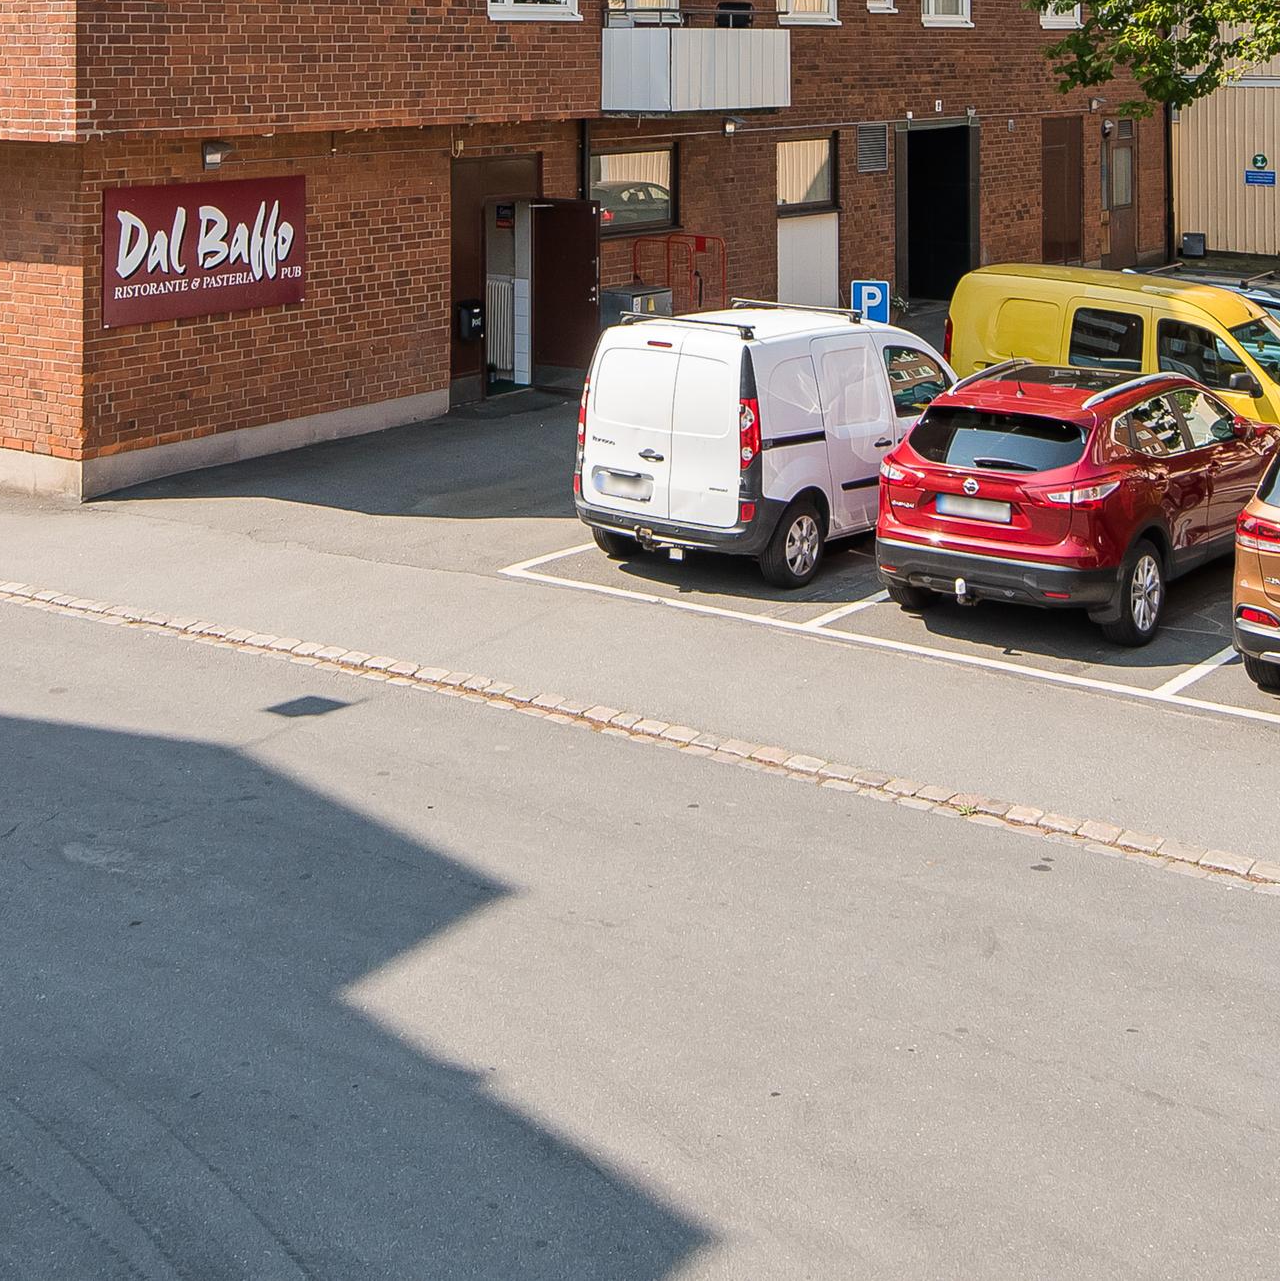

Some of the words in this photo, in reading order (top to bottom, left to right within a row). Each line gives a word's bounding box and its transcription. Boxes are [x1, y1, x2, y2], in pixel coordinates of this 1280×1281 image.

[115, 206, 187, 278] Dal
[197, 200, 294, 280] Baffo
[114, 278, 189, 299] RISTORANTE
[191, 278, 200, 289] &
[202, 271, 254, 289] PASTERIA
[281, 266, 302, 279] PUB
[862, 286, 882, 319] P
